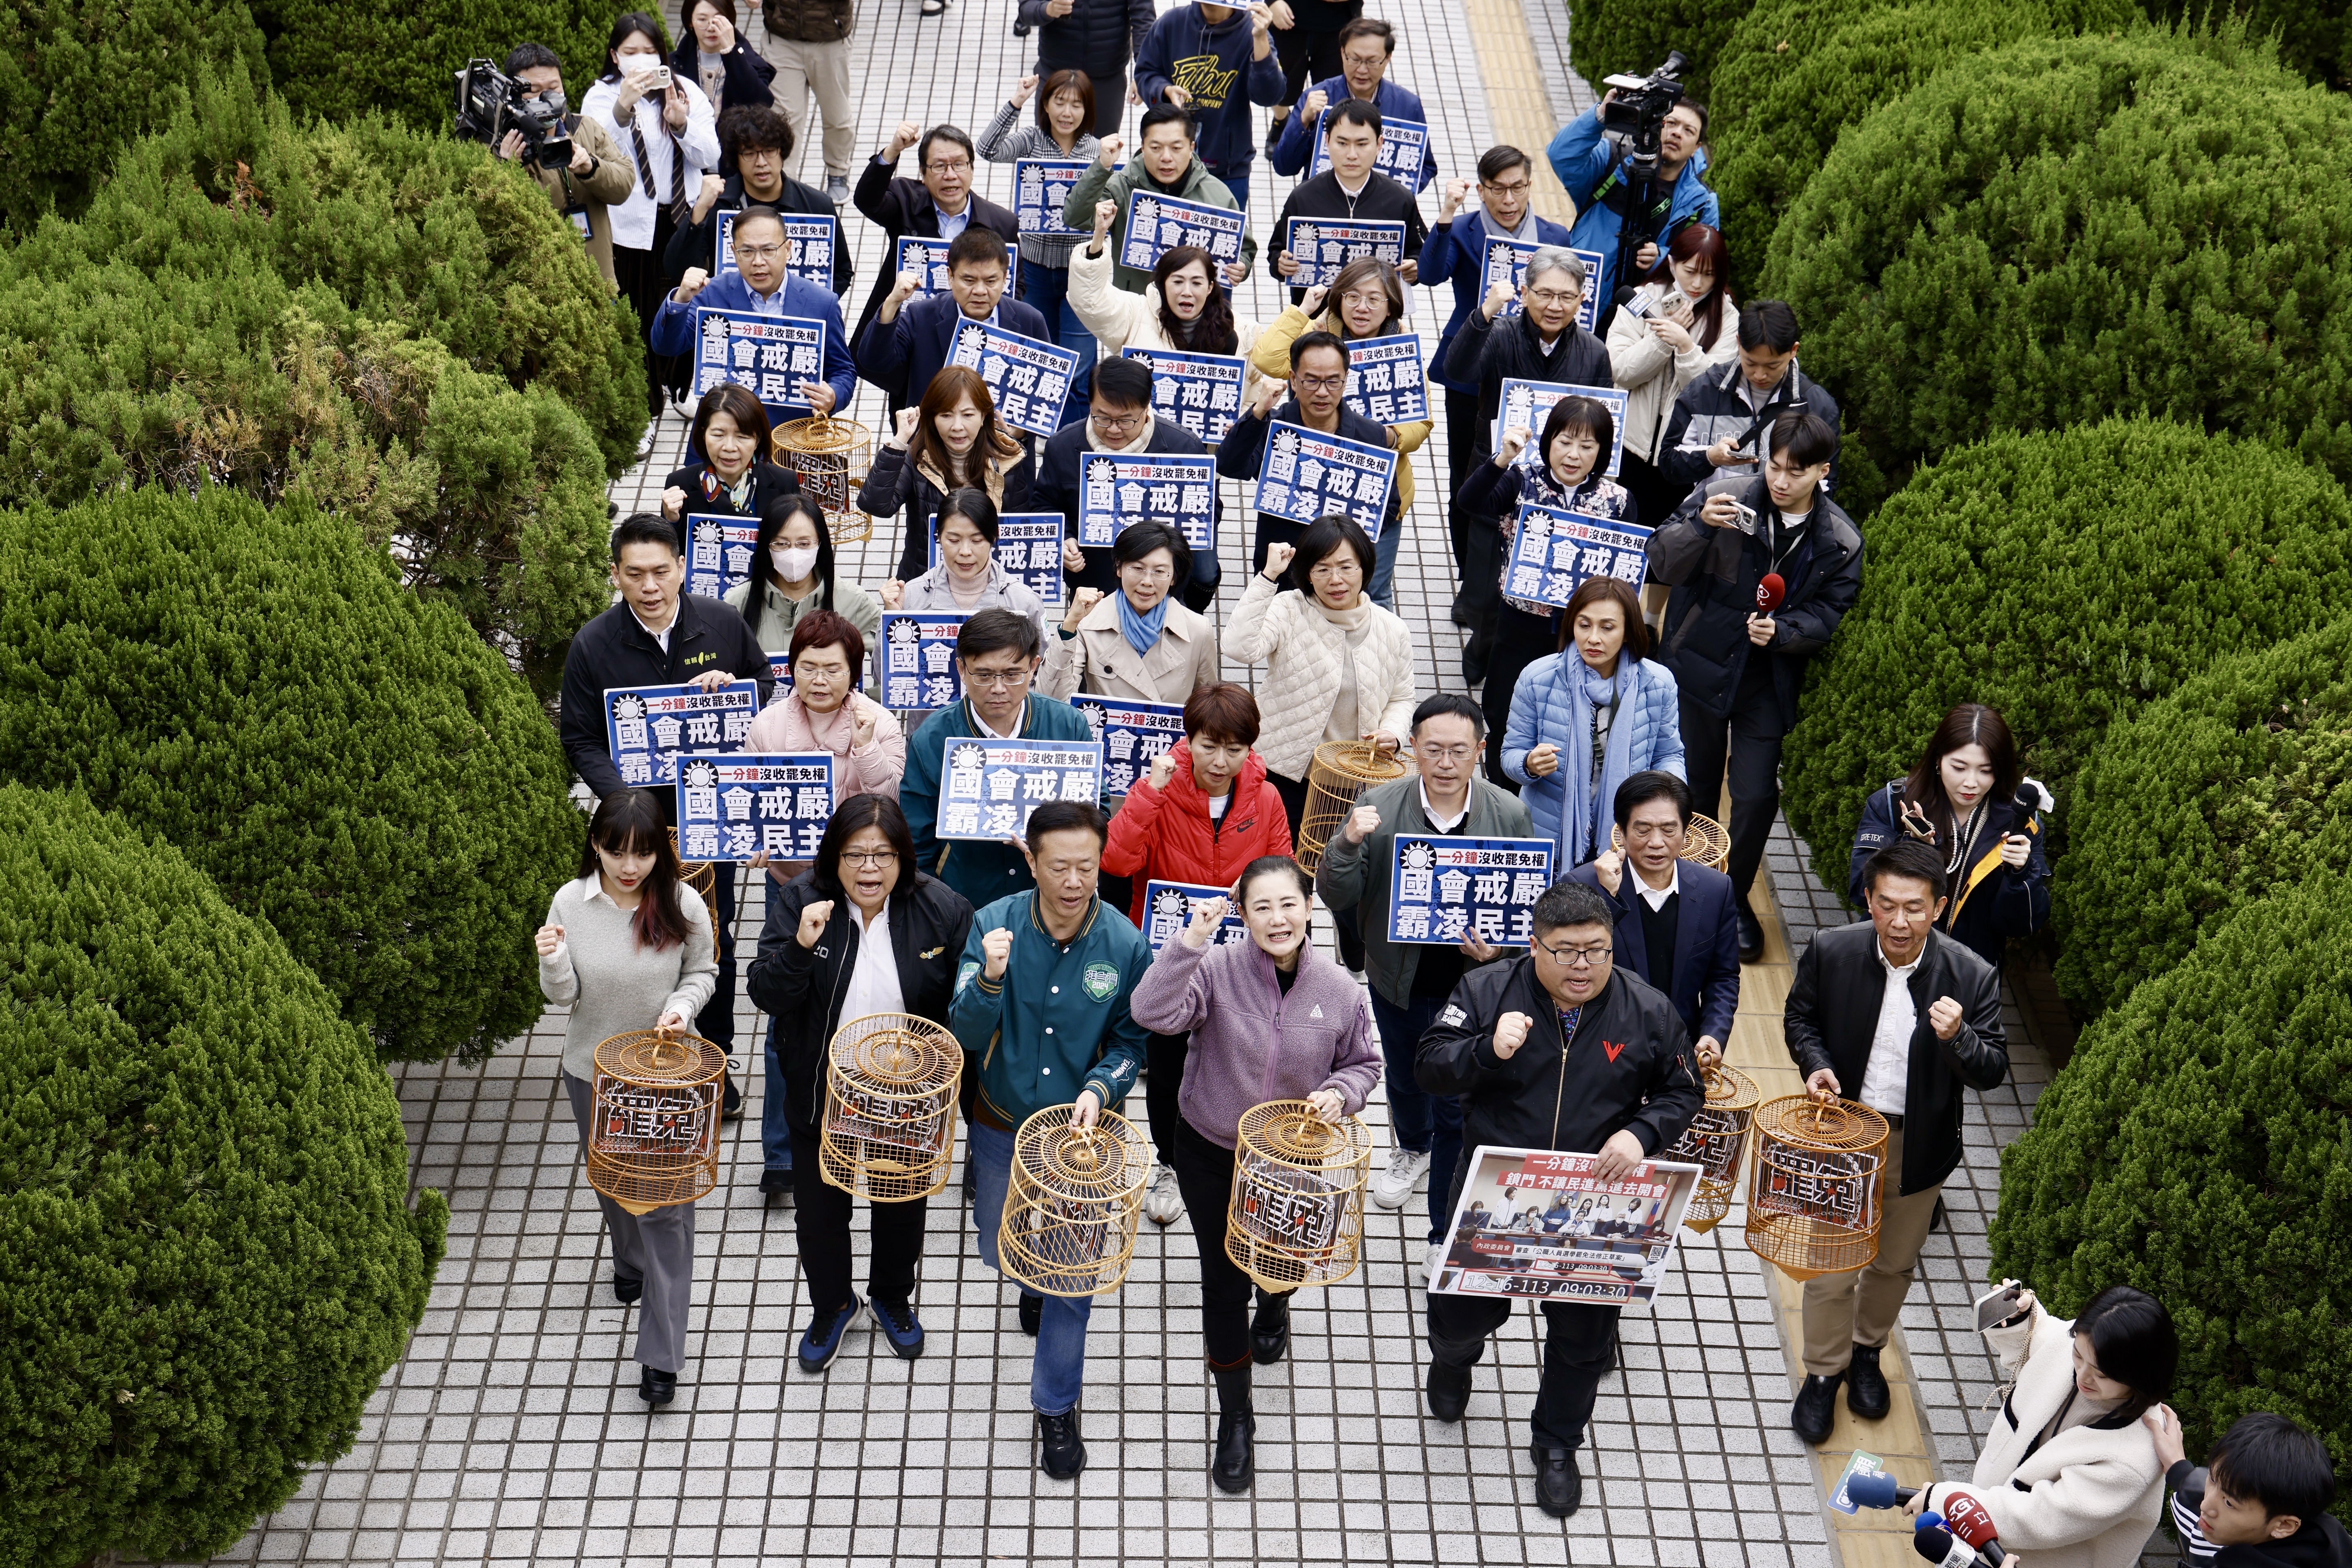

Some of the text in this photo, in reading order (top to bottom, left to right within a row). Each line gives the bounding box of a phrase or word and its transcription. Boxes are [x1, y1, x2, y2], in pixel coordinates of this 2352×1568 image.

[1019, 183, 1070, 207] 國會
[1018, 208, 1073, 232] 霸凌
[1162, 209, 1240, 231] 一分鐘沒收罷免權
[1131, 215, 1238, 259] 國會戒嚴
[1321, 229, 1399, 241] 一分鐘沒收罷免權
[1293, 239, 1400, 266] 國會戒嚴
[1291, 264, 1343, 288] 霸凌
[732, 324, 816, 342] 一分鐘沒收罷免權
[701, 335, 818, 375] 國會戒嚴
[988, 340, 1069, 372] 一分鐘沒收罷免權
[1349, 344, 1416, 362] 鐘沒收罷免權
[952, 343, 1066, 404] 國會戒嚴
[1155, 362, 1238, 379] 一分鐘沒收罷免權
[1342, 359, 1422, 396] 會戒嚴
[1153, 376, 1238, 412] 會戒嚴
[1302, 443, 1388, 473] 一分鐘沒收罷免權
[1118, 467, 1208, 479] 一分鐘沒收罷免權
[1266, 450, 1385, 507] 國會戒嚴
[1086, 481, 1210, 514] 國會戒嚴
[999, 525, 1057, 537] 沒收罷免權
[1555, 524, 1645, 550] 一分鐘沒收罷免權
[692, 541, 754, 574] 國會
[1517, 533, 1643, 585] 國會戒嚴
[1510, 565, 1577, 604] 霸凌
[888, 642, 954, 673] 國會
[648, 693, 750, 711] 一分鐘沒收罷免權
[888, 676, 965, 707] 霸凌
[615, 711, 754, 750] 國會戒嚴
[1108, 713, 1184, 729] 一分鐘沒收罷
[988, 753, 1093, 767] 一分鐘沒收罷免權
[720, 768, 825, 781] 一分鐘沒收罷免權
[948, 768, 1095, 802] 國會戒嚴
[684, 786, 829, 821] 國會戒嚴
[945, 802, 1036, 836] 霸凌
[685, 823, 826, 857] 霸凌民主
[1438, 851, 1545, 866] 一分鐘沒收罷免權
[1399, 869, 1547, 906] 國會戒嚴
[1396, 905, 1533, 942] 霸凌民主
[1092, 981, 1109, 991] 2024
[1505, 1172, 1535, 1187] 鎖門
[1476, 1242, 1511, 1251] 內政委員會
[1538, 1261, 1607, 1272] 12-16-113 09:03:30
[1465, 1275, 1626, 1299] 12-16-113 09:03:30
